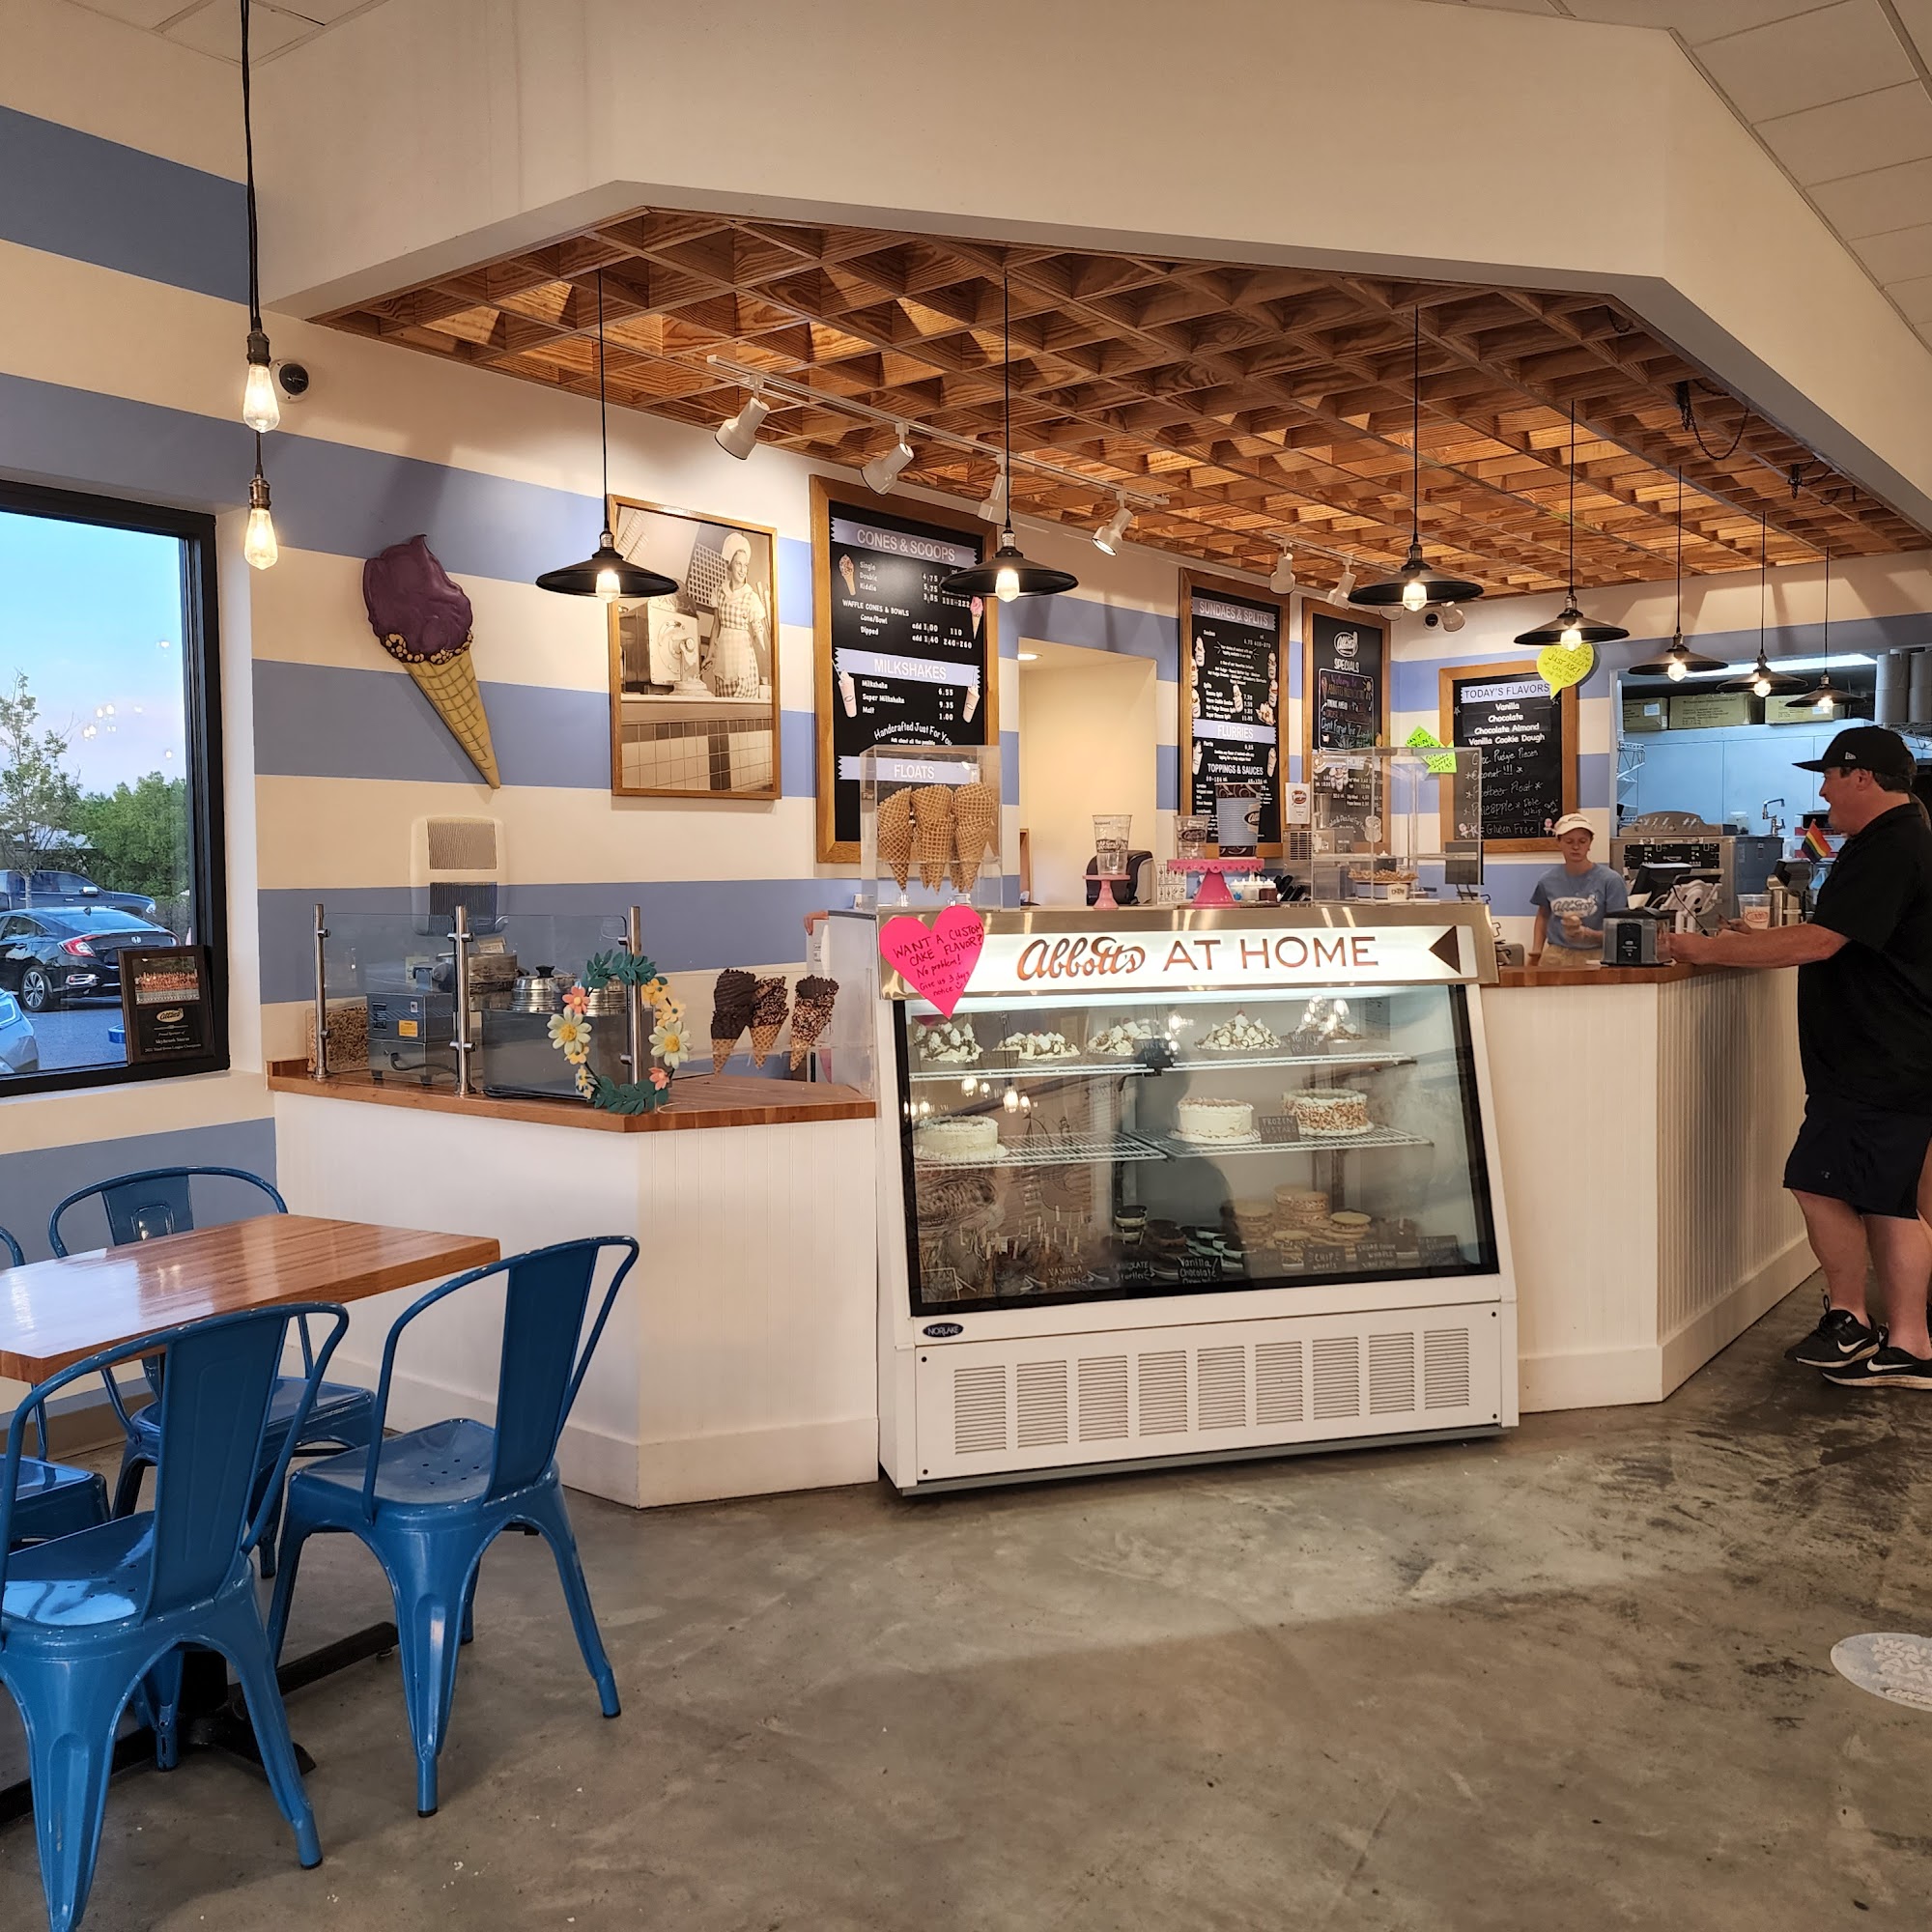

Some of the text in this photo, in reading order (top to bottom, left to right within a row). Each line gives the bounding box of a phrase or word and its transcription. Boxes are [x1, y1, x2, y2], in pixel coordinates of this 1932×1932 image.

[857, 529, 955, 562] CONES & SCOOPS
[860, 562, 876, 572] Single
[842, 599, 864, 610] WAFFLE
[866, 603, 883, 612] CONES
[891, 607, 910, 616] BOWLS
[1199, 601, 1236, 619] SUNDAES
[1244, 611, 1268, 626] SPLITS
[874, 658, 947, 680] MILKSHAKES
[1334, 658, 1360, 673] SPECIALS
[1464, 683, 1550, 699] TODAY'S FLAVORS
[1495, 701, 1520, 711] Vanilla
[1488, 713, 1524, 723] Chocolate
[873, 721, 914, 740] Handcrafted
[914, 723, 928, 733] Just
[929, 725, 941, 738] For
[1218, 724, 1254, 739] FLURRIES
[1474, 723, 1540, 735] Chocolate Almond
[1468, 732, 1546, 746] Vanilla Cookie Dough
[894, 764, 935, 780] FLOATS
[1208, 763, 1236, 774] TOPPINGS
[1242, 765, 1264, 775] SAUCES
[1514, 823, 1537, 834] Free
[893, 923, 984, 958] WANT A CUSTOM
[909, 934, 982, 967] CAKE FLAVOR?
[1162, 939, 1221, 972] AT
[1239, 936, 1379, 969] HOME
[917, 953, 961, 979] No problem!
[919, 980, 935, 991] Give
[933, 986, 953, 996] notice
[1262, 1117, 1293, 1126] FROZEN
[1261, 1125, 1297, 1134] CUSTARD
[927, 1325, 959, 1336] NORLAKE
